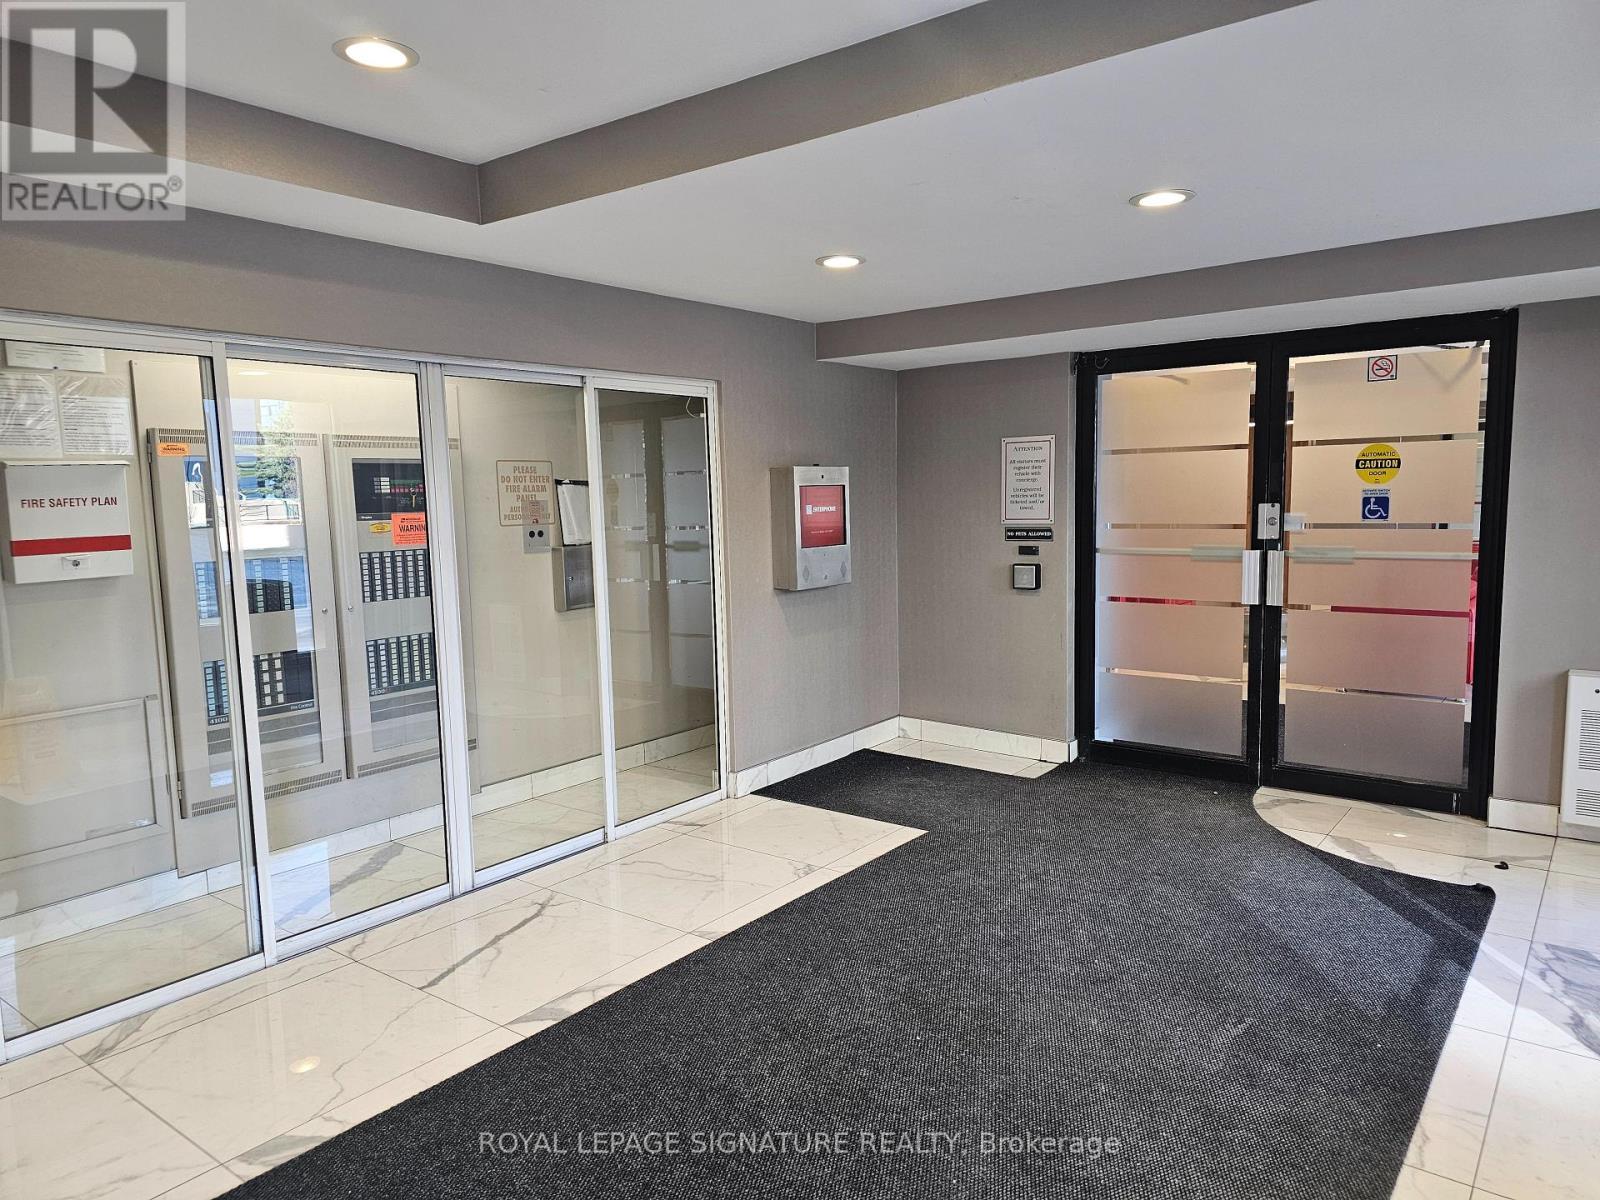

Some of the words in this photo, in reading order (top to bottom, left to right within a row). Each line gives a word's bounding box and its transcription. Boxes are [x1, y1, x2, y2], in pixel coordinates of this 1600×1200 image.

[1358, 459, 1398, 469] CAUTION
[513, 466, 537, 474] PLEASE
[500, 476, 511, 484] DO
[512, 476, 527, 484] NOT
[529, 475, 550, 484] ENTER
[505, 485, 521, 493] FIRE
[522, 484, 547, 493] ALARM
[21, 498, 46, 509] FIRE
[49, 498, 88, 508] SAFETY
[91, 496, 118, 506] PLAN
